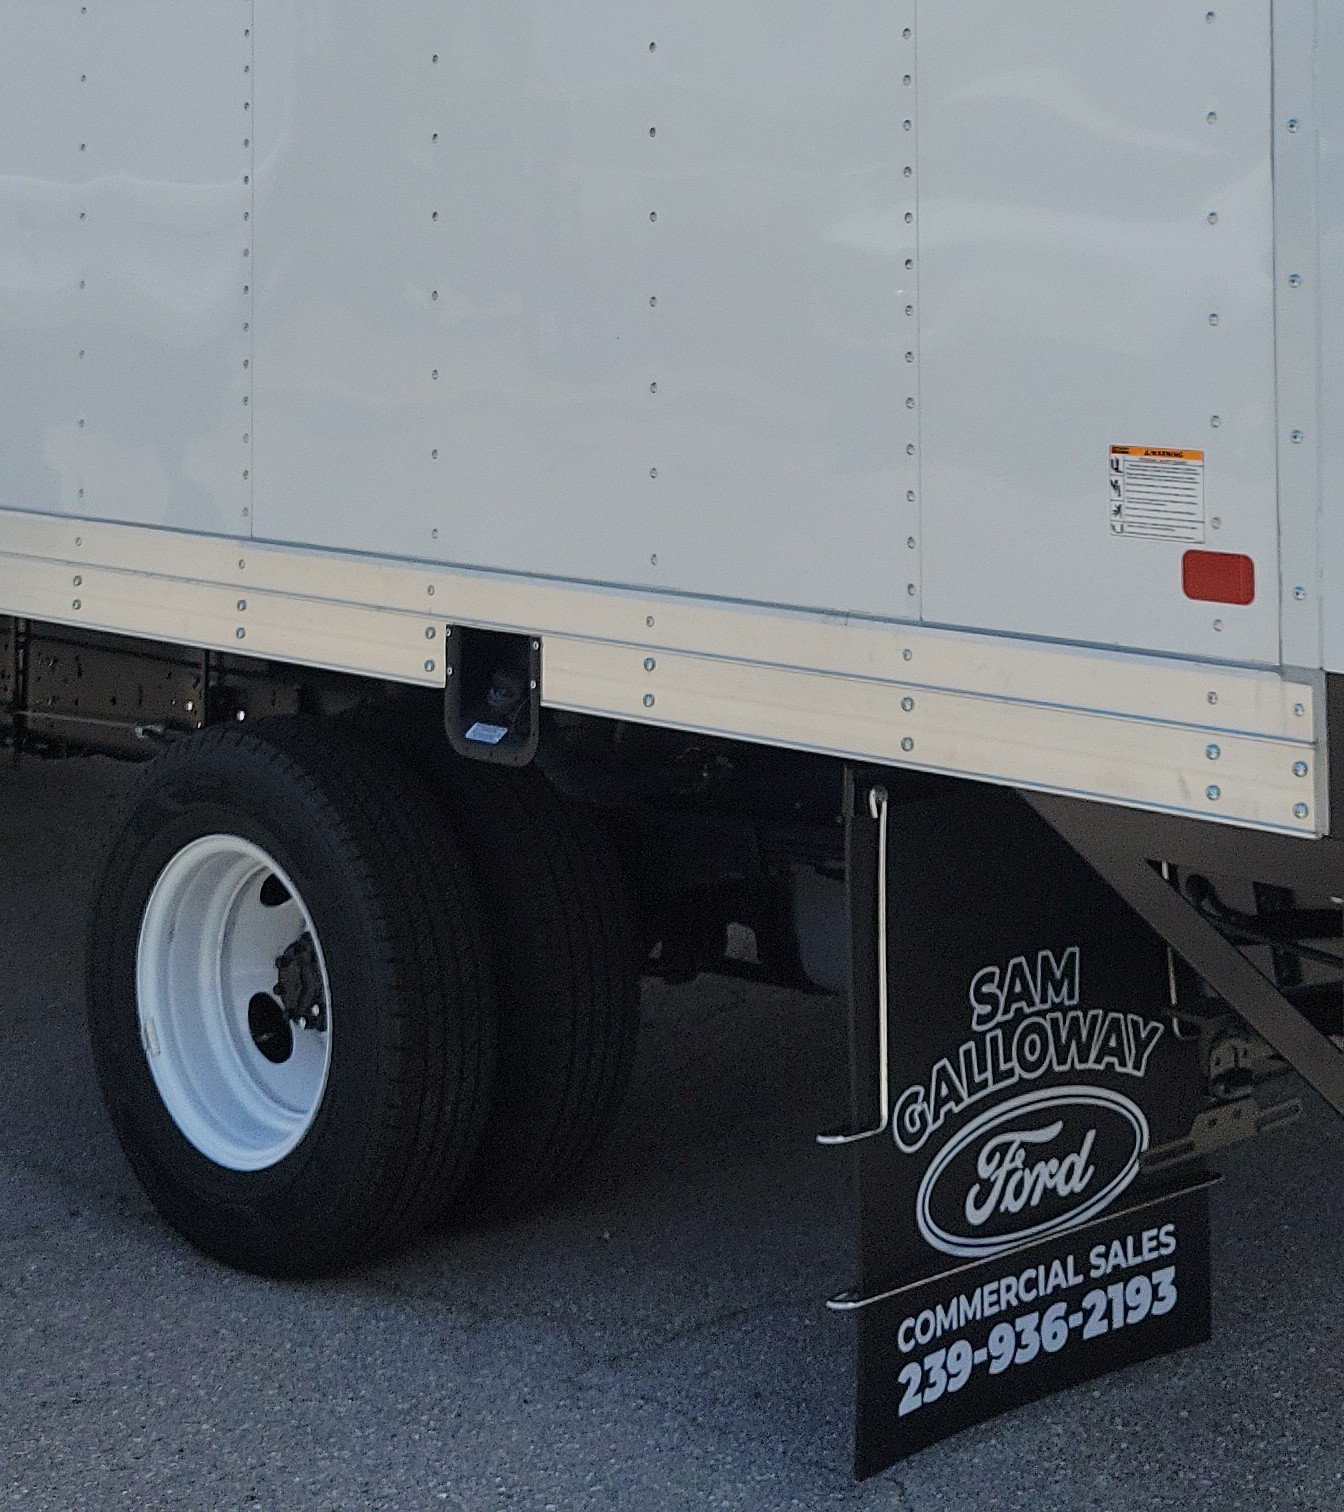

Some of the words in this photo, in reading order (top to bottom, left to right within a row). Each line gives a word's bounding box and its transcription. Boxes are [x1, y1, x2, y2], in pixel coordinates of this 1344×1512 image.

[969, 945, 1080, 1032] SAM
[892, 1008, 1165, 1154] GALLOWAY
[964, 1119, 1097, 1227] Ford
[896, 1253, 1084, 1355] COMMERCIAL
[1089, 1222, 1177, 1281] SALES
[896, 1266, 1178, 1418] 239-936-2193
